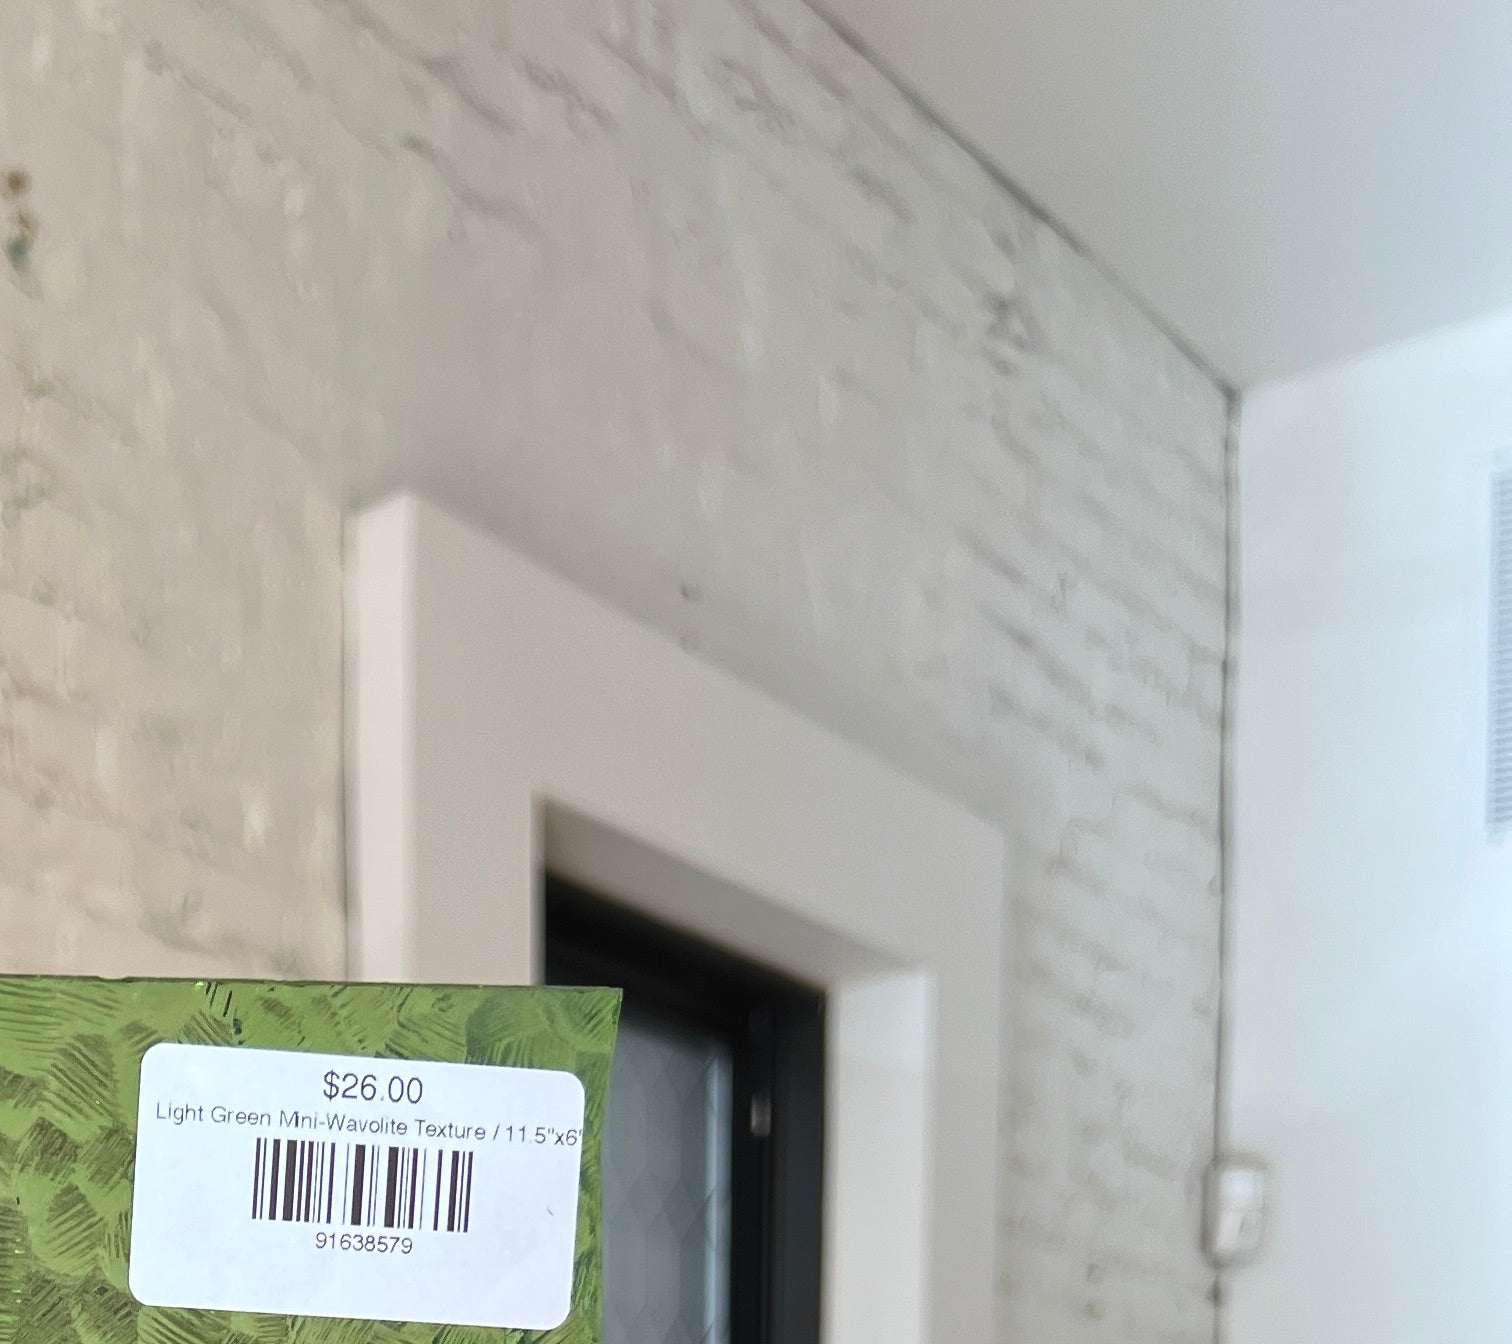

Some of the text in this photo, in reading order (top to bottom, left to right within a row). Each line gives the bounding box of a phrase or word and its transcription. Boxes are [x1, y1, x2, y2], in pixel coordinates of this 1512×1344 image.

[323, 1069, 423, 1104] $26.00
[156, 1102, 204, 1126] Light
[211, 1105, 271, 1127] Green
[414, 1118, 486, 1141] Texture
[492, 1123, 501, 1142] /
[315, 1231, 413, 1255] 91638579
